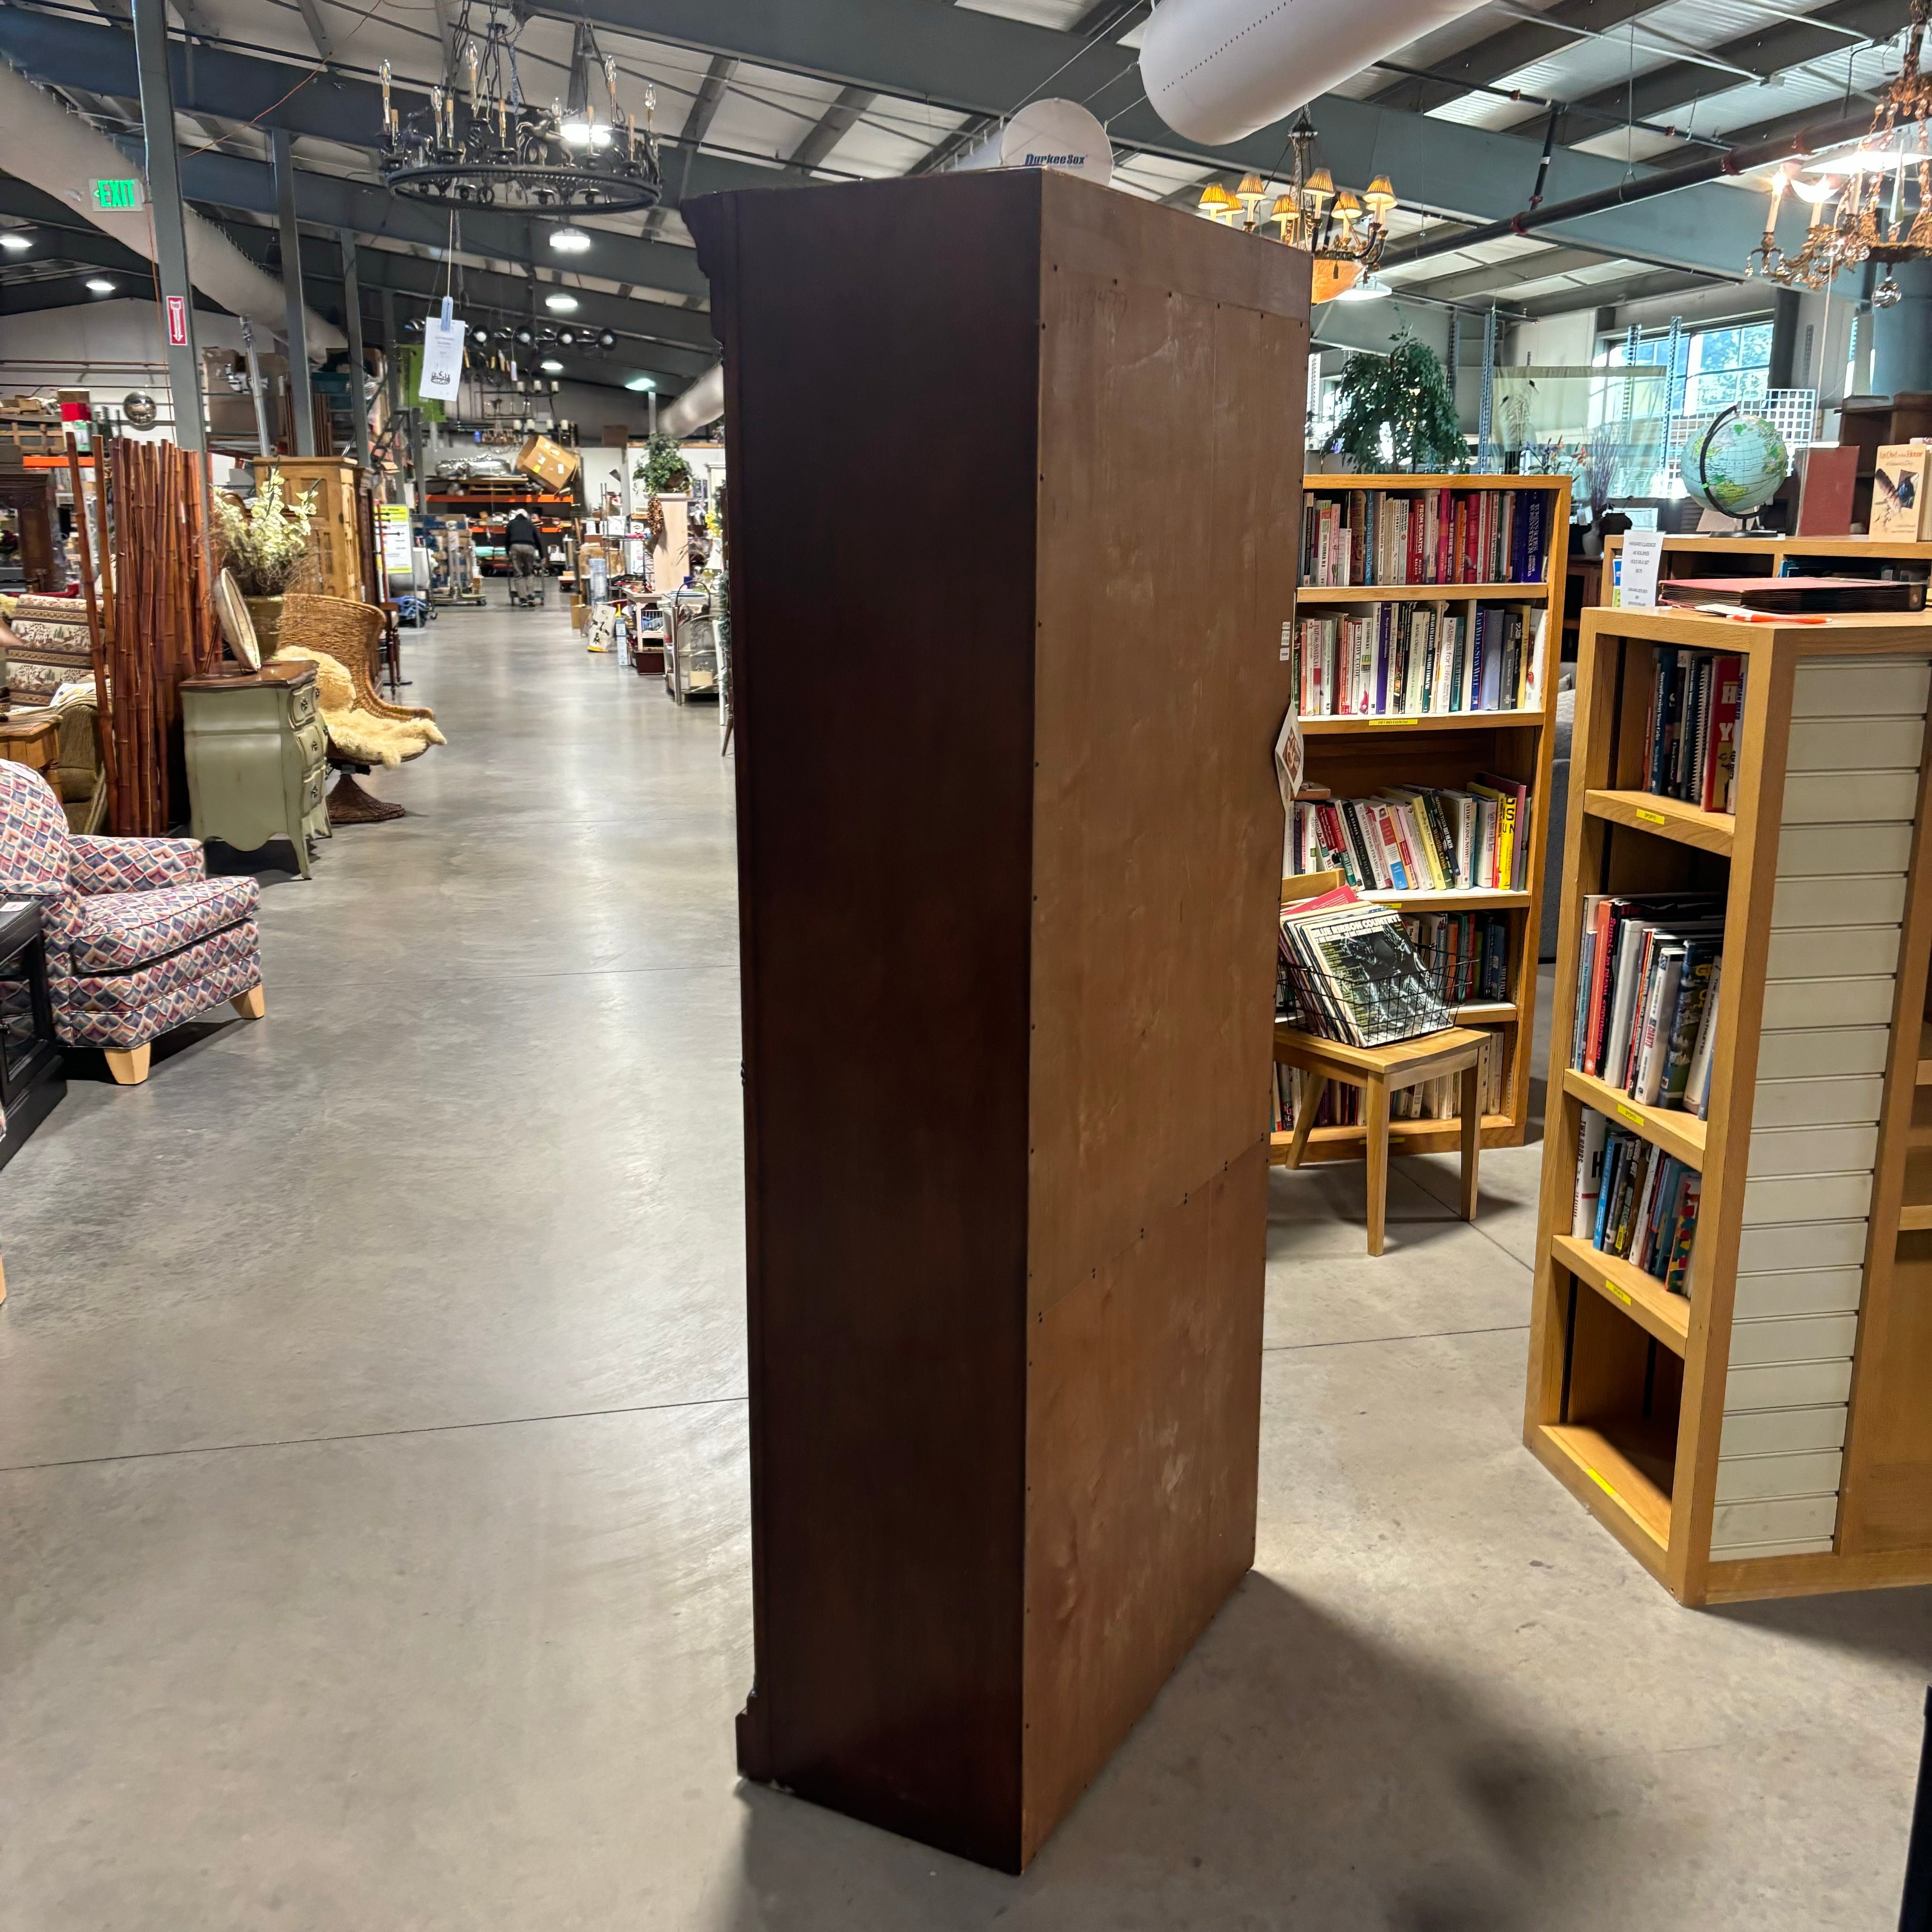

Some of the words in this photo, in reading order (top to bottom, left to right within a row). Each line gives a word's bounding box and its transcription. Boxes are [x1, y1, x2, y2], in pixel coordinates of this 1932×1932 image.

[98, 180, 134, 207] EXIT
[1472, 667, 1481, 688] WELL
[1433, 828, 1443, 851] Wildlife
[1439, 852, 1447, 869] Crisis
[1445, 834, 1454, 849] HEALTH
[1312, 926, 1332, 938] BLUE
[1331, 922, 1362, 934] RIBBON
[1362, 914, 1402, 928] COUNTRY!
[1707, 993, 1715, 1017] SUPER
[1644, 1026, 1656, 1048] GIANTS
[1698, 1018, 1710, 1056] ATHLETES
